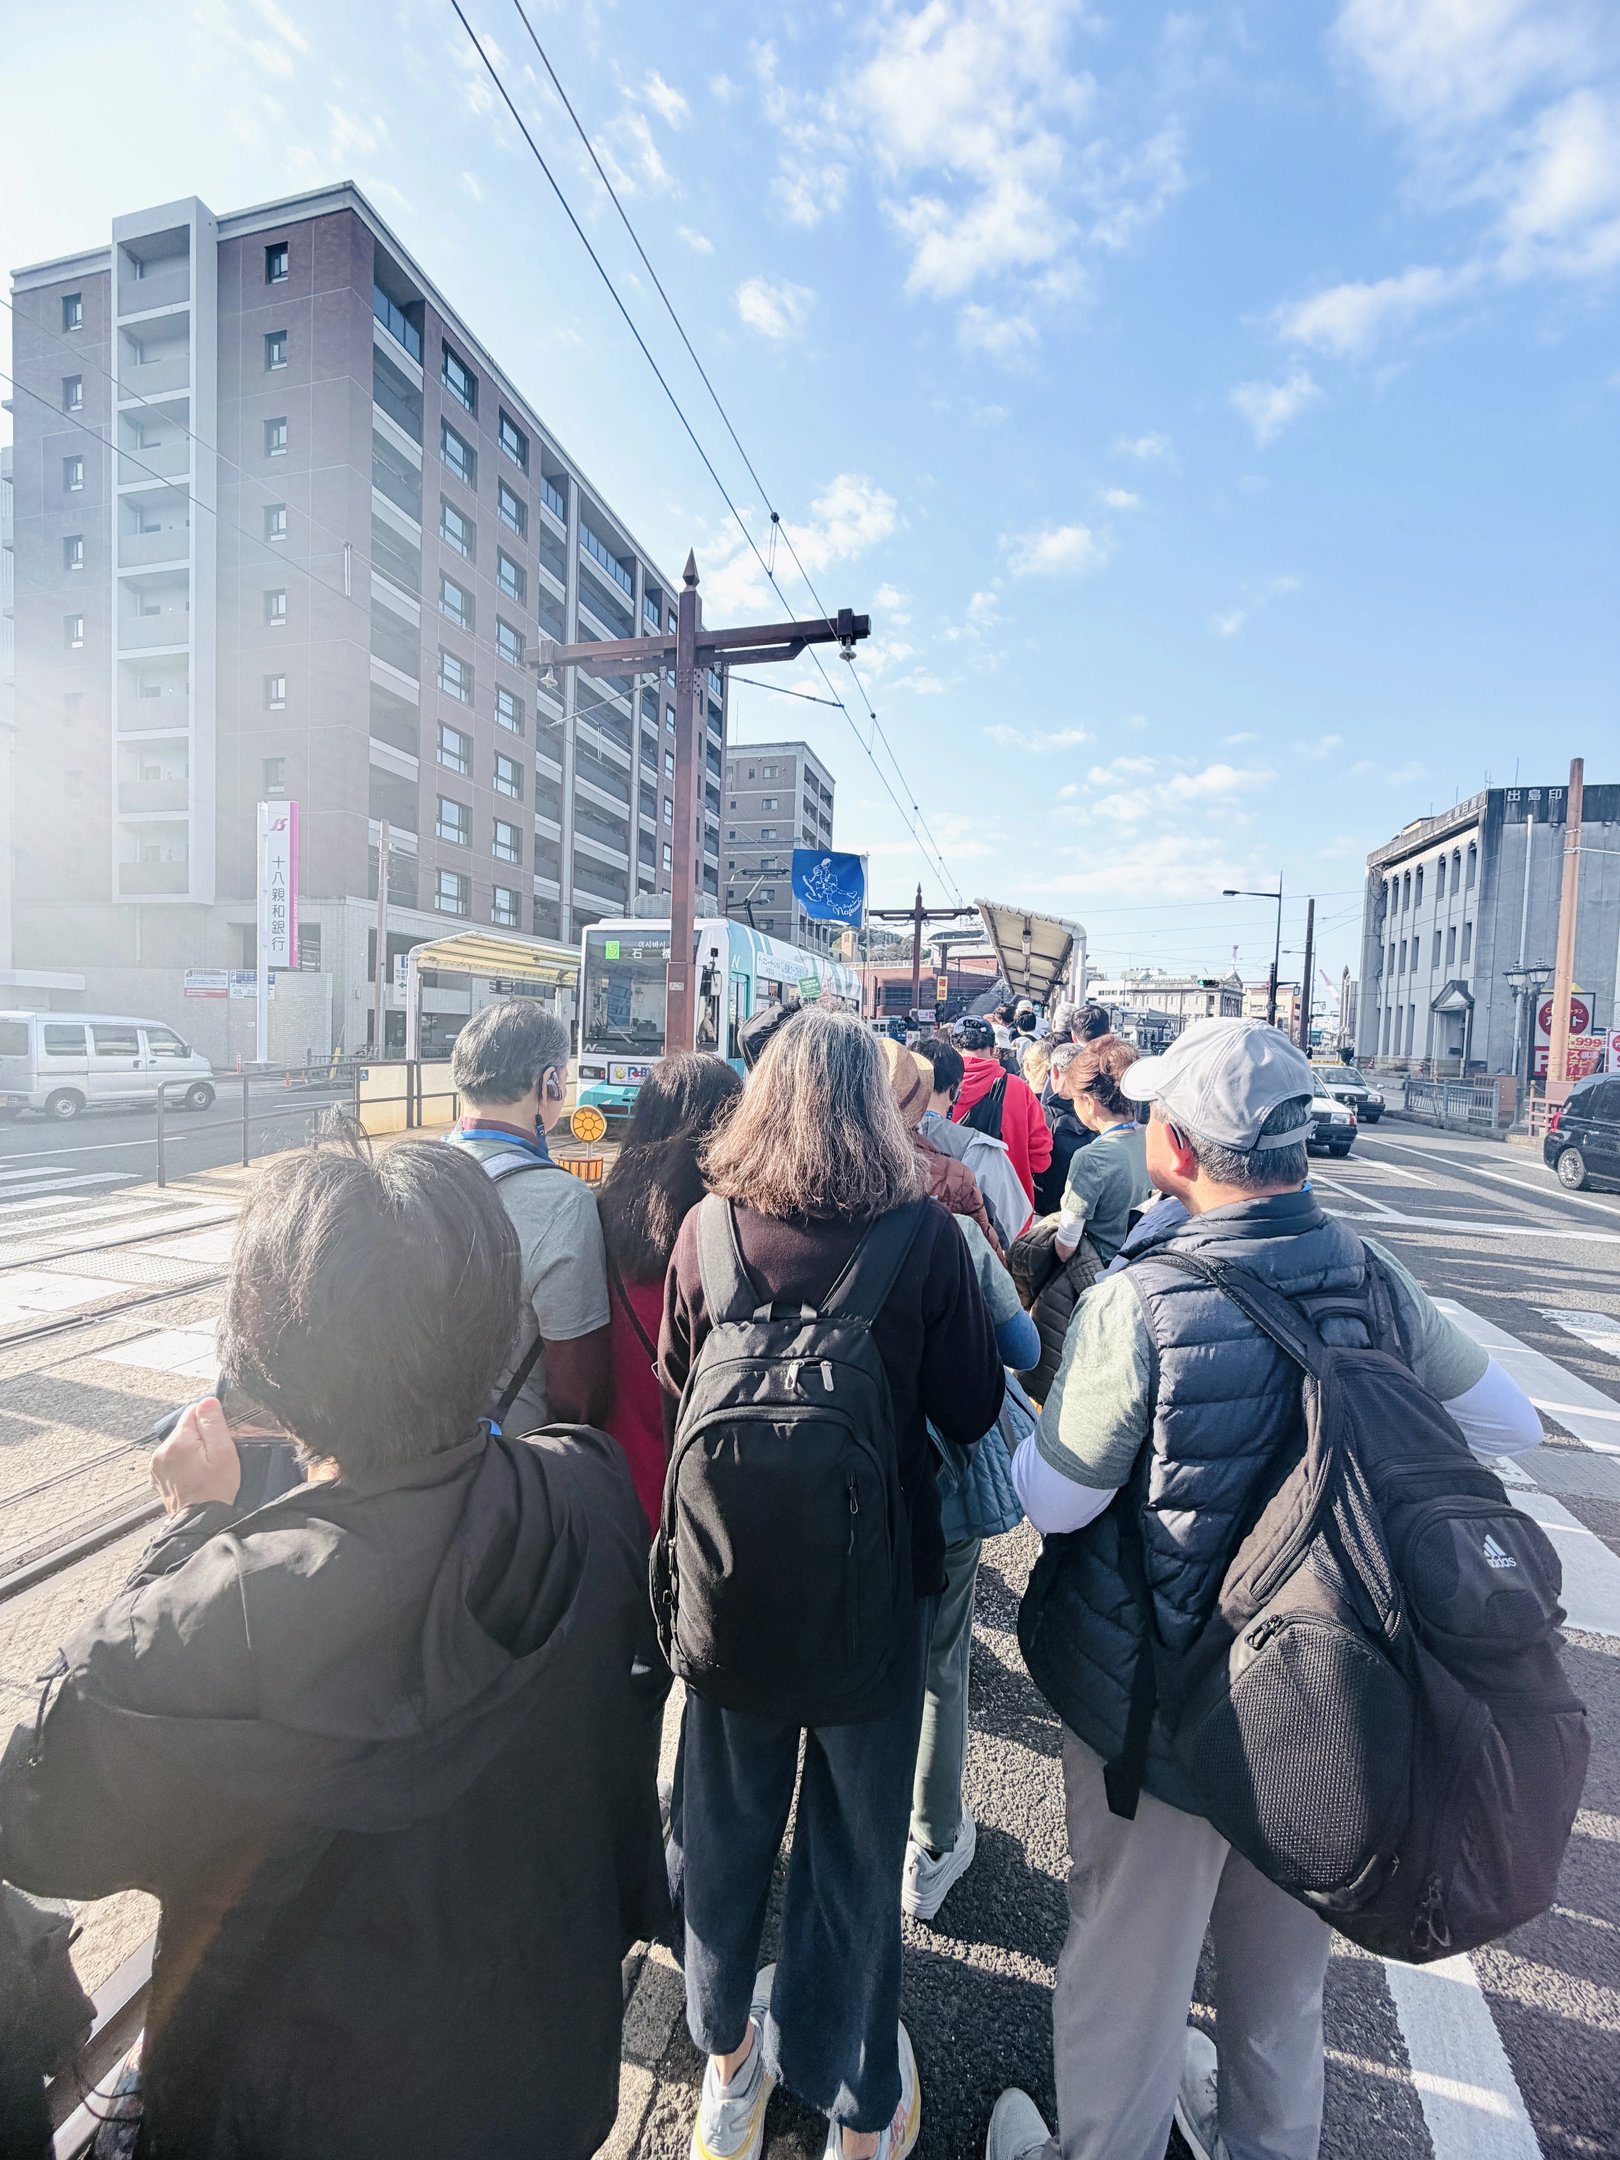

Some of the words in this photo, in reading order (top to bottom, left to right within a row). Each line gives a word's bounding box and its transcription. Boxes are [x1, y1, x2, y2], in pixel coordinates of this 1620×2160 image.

[272, 855, 285, 951] 十八親和銀行
